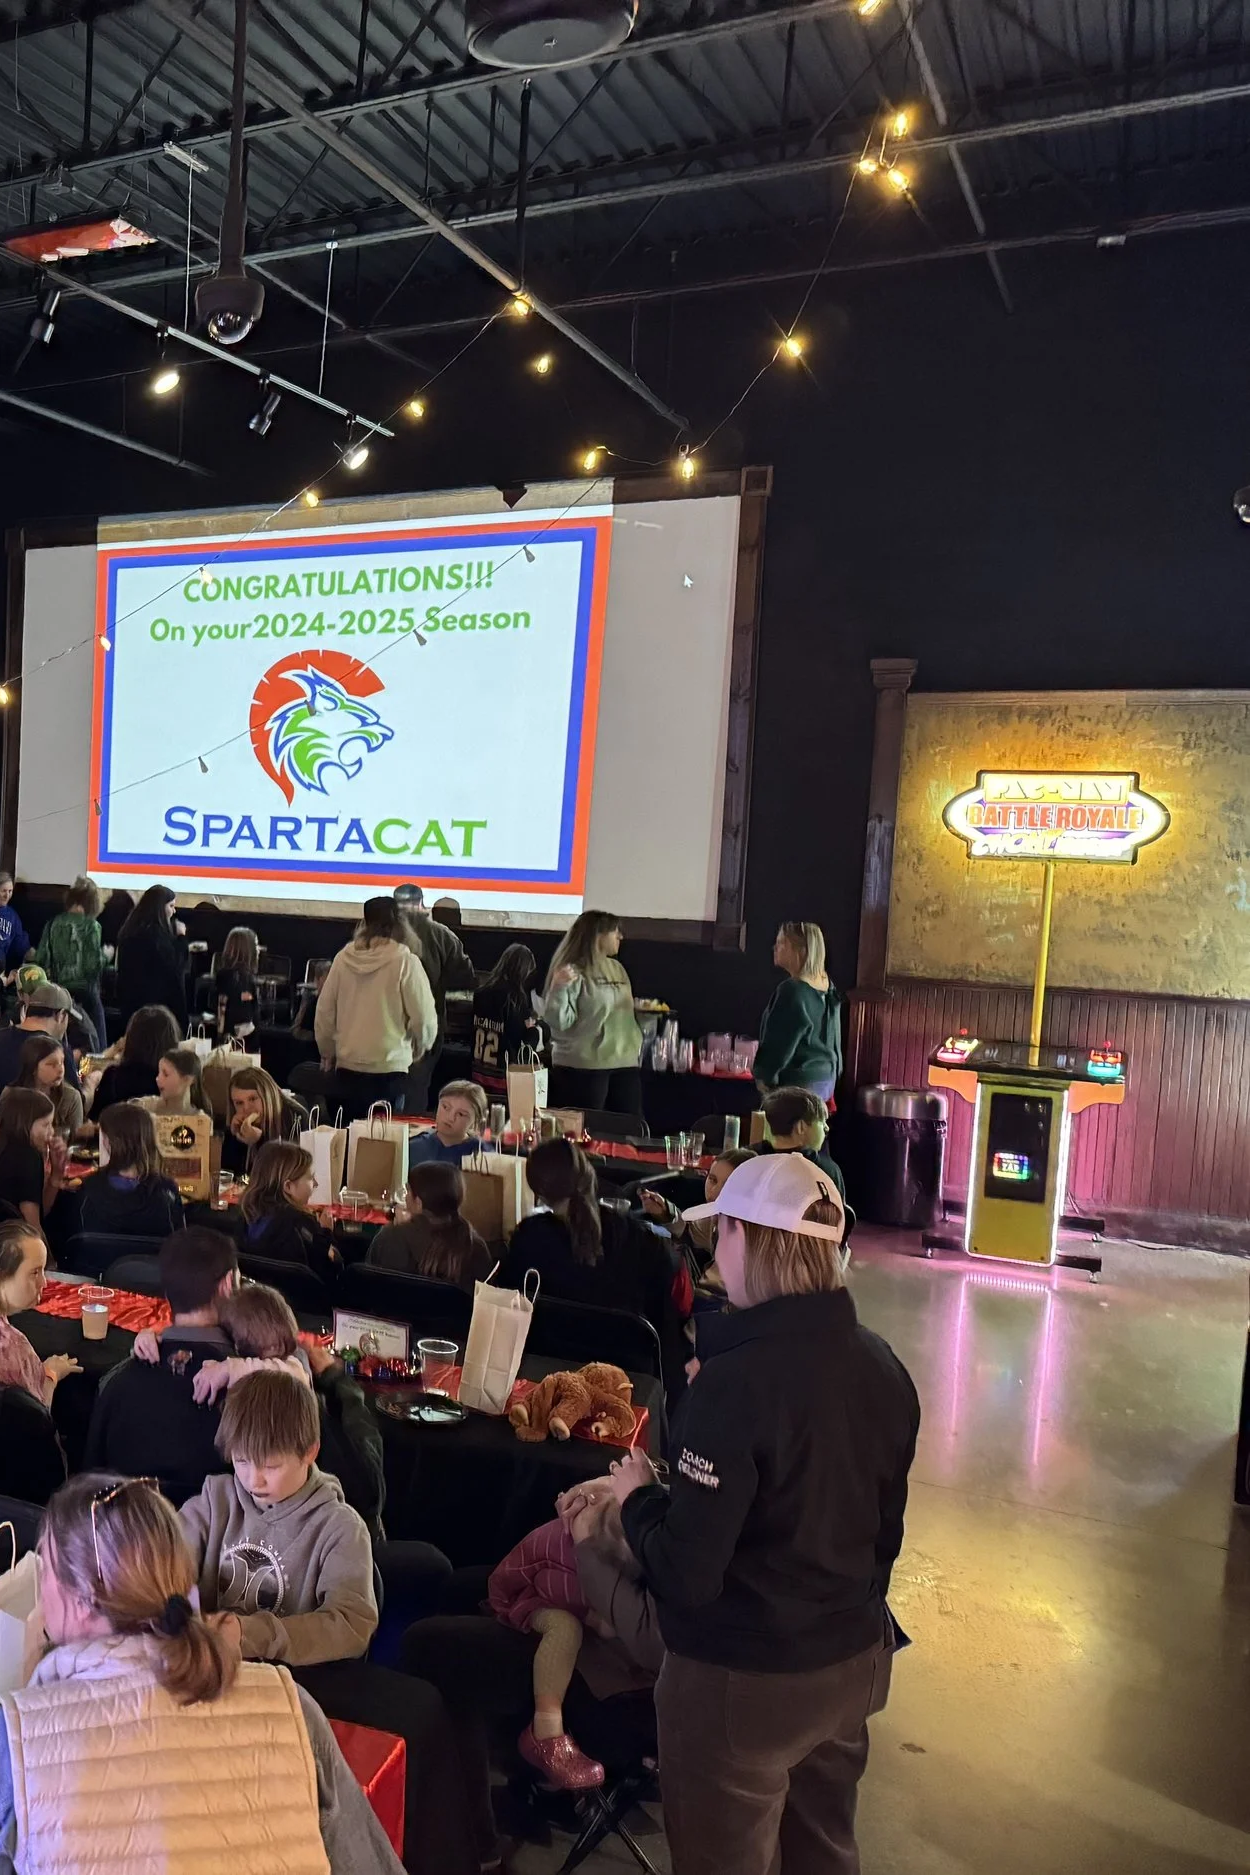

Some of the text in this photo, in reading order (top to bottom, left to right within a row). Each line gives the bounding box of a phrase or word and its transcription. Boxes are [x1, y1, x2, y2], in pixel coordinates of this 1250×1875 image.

[183, 560, 493, 602] CONGRATULATIONS!!!
[150, 618, 185, 642] On
[422, 606, 531, 632] Season
[163, 805, 487, 857] SPARTACAT
[968, 804, 1142, 830] BATTLE ROYALE
[682, 1447, 714, 1473] COACH
